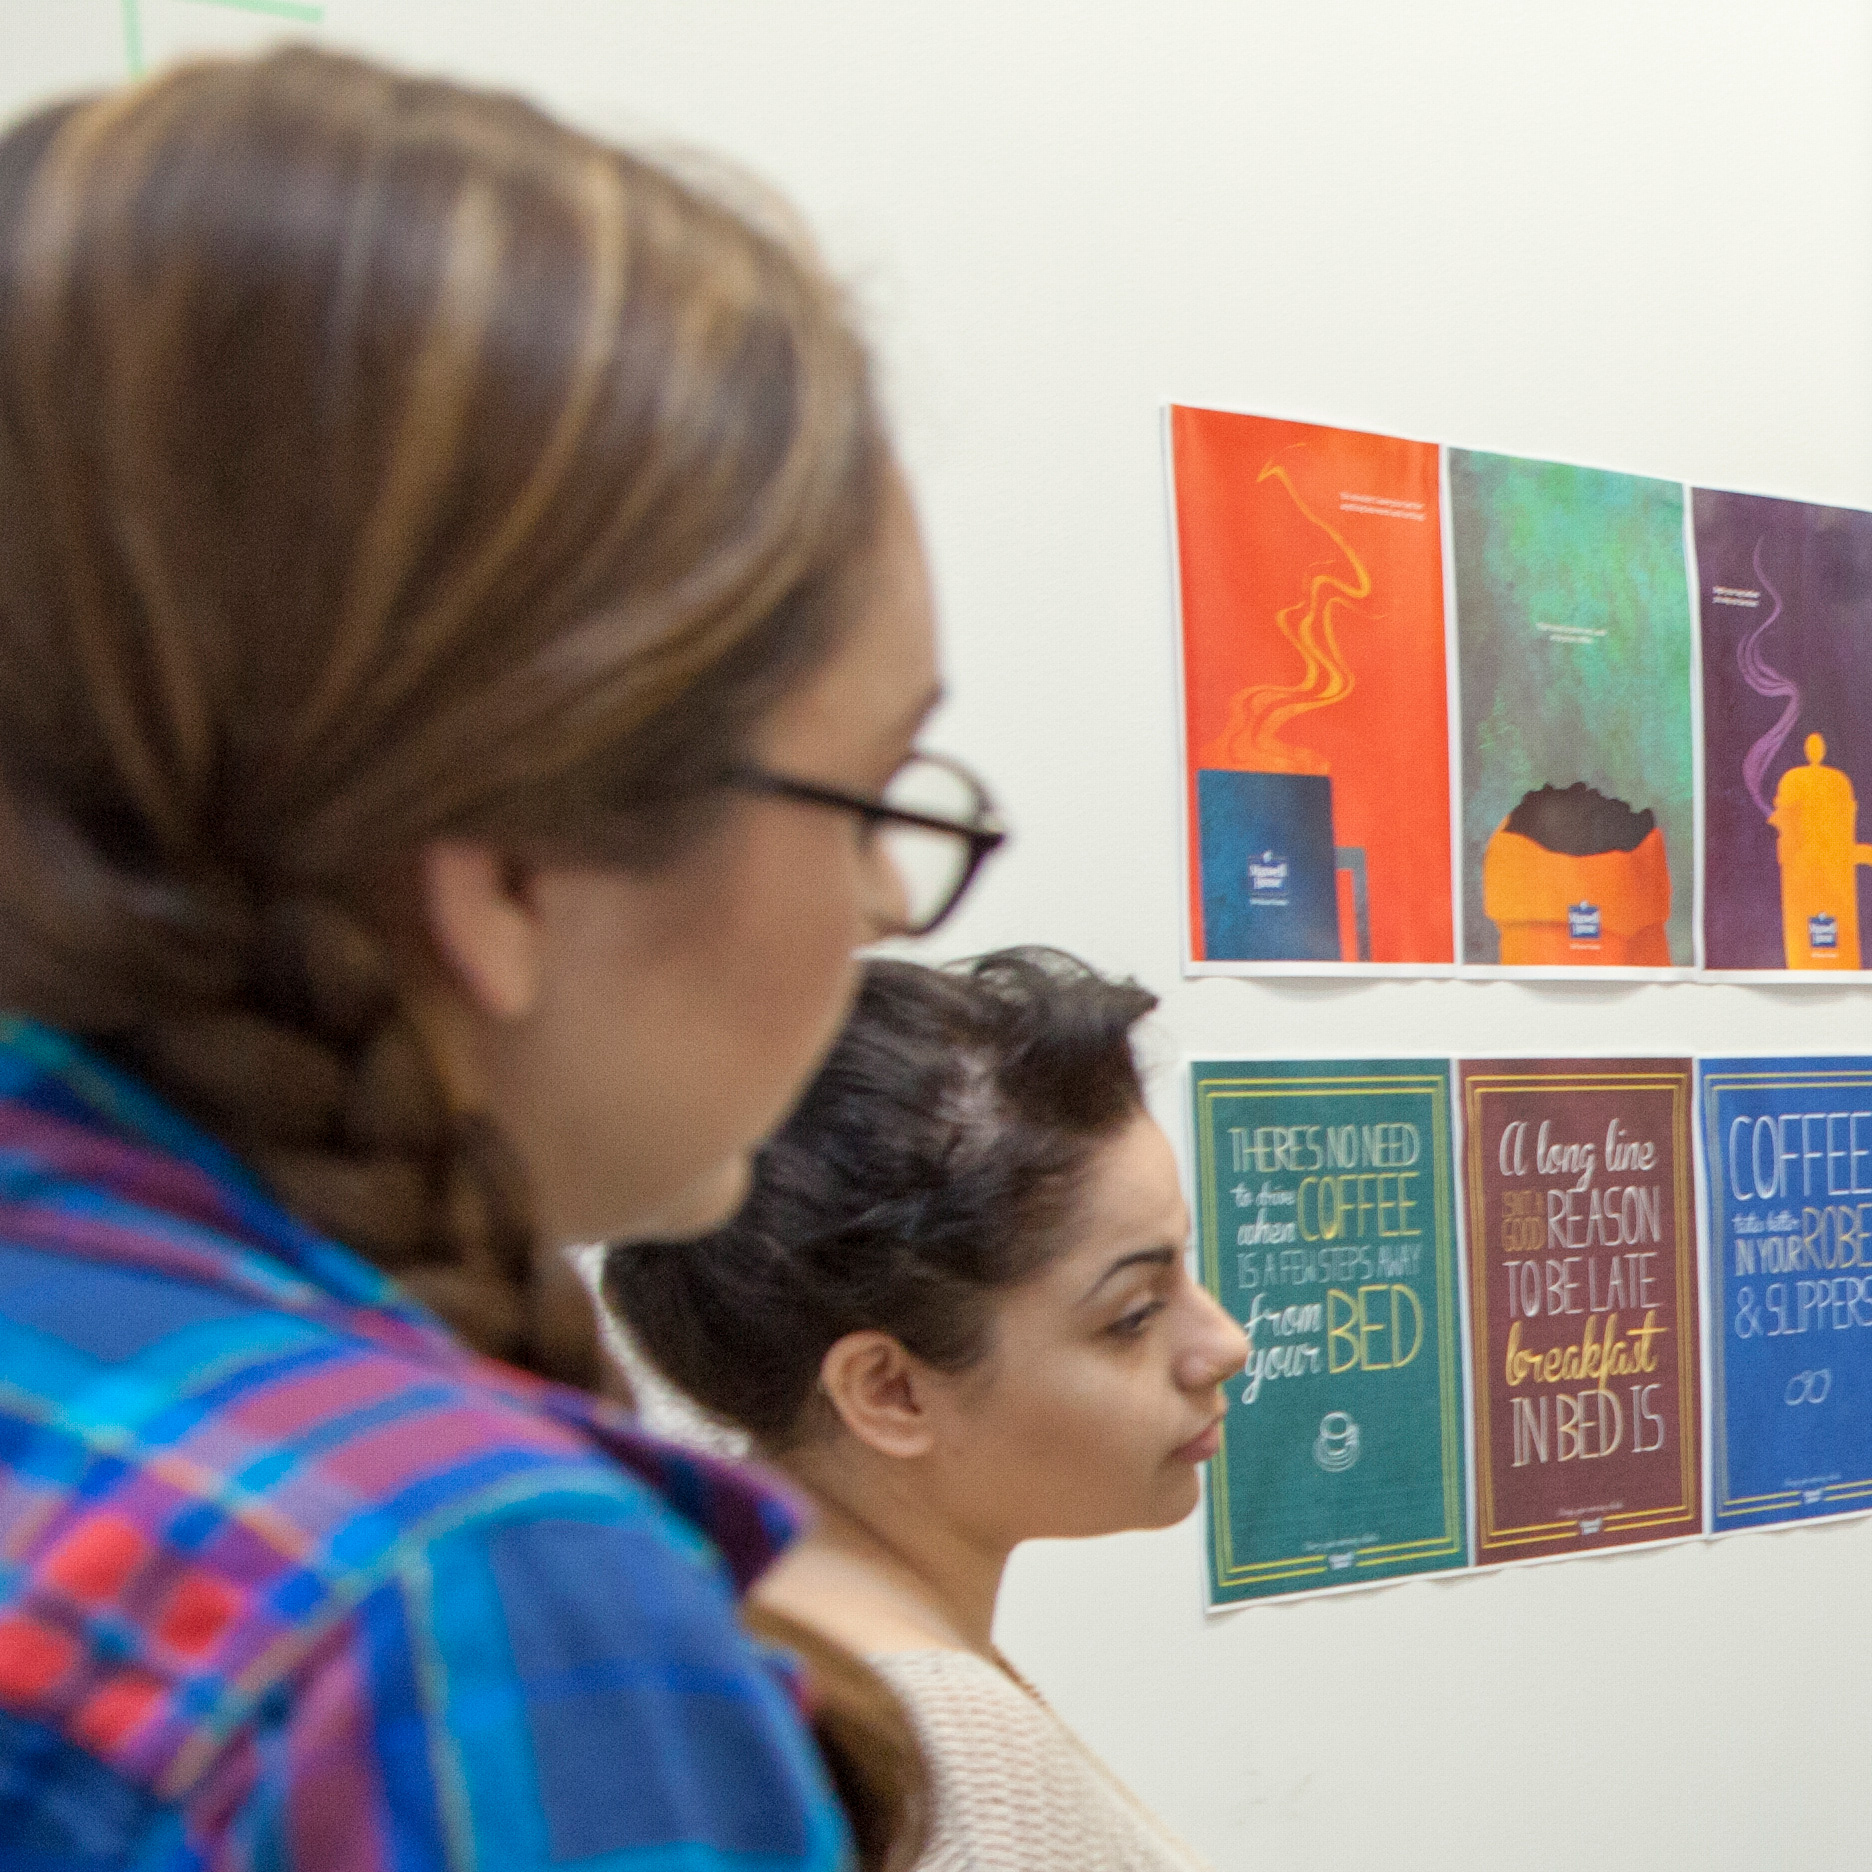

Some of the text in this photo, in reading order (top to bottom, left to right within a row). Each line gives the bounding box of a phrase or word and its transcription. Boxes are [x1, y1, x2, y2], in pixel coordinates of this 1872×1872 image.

[1326, 1123, 1359, 1169] NO
[1362, 1122, 1421, 1168] NEED
[1536, 1119, 1597, 1193] long
[1605, 1117, 1658, 1172] line
[1230, 1182, 1253, 1208] to
[1298, 1171, 1422, 1242] COFFEE
[1547, 1185, 1661, 1249] REASON
[1237, 1208, 1296, 1246] when
[1734, 1234, 1803, 1277] IN YOUR
[1237, 1252, 1260, 1290] IS
[1263, 1252, 1276, 1287] A
[1279, 1249, 1318, 1286] FEW
[1318, 1245, 1374, 1284] STEPS
[1502, 1252, 1663, 1319] TO BE LATE
[1244, 1292, 1323, 1341] from
[1326, 1283, 1424, 1374] BED
[1734, 1285, 1765, 1340] &
[1242, 1342, 1321, 1405] your
[1505, 1309, 1670, 1392] breakfast
[1509, 1383, 1666, 1468] IN BED IS
